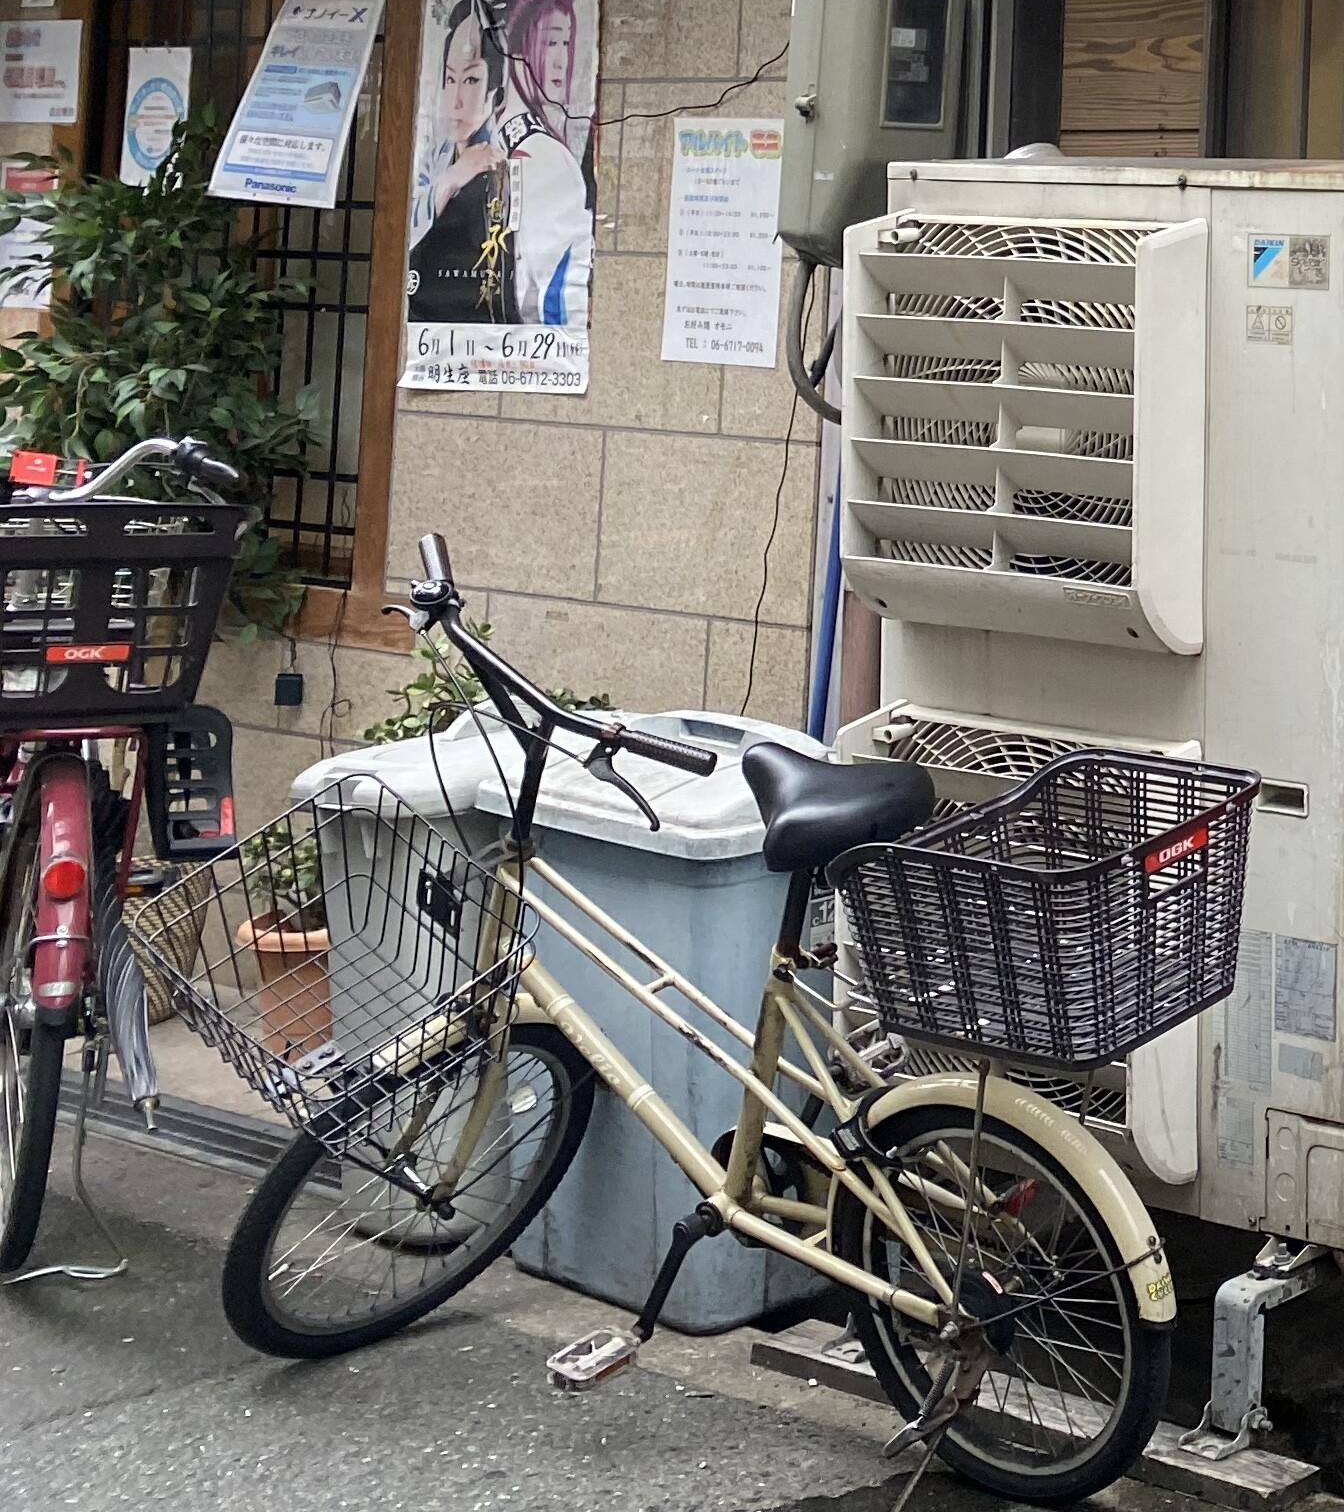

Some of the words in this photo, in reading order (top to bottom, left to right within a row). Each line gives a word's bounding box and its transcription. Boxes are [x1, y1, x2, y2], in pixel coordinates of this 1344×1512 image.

[244, 177, 297, 194] Panasonic
[1254, 239, 1285, 247] DAIKIN
[685, 337, 699, 349] TEL
[427, 362, 471, 386] 明生座
[478, 369, 498, 386] 電話
[501, 369, 582, 387] 06-6712-3303
[64, 646, 103, 660] OGK
[1159, 835, 1195, 864] OGK
